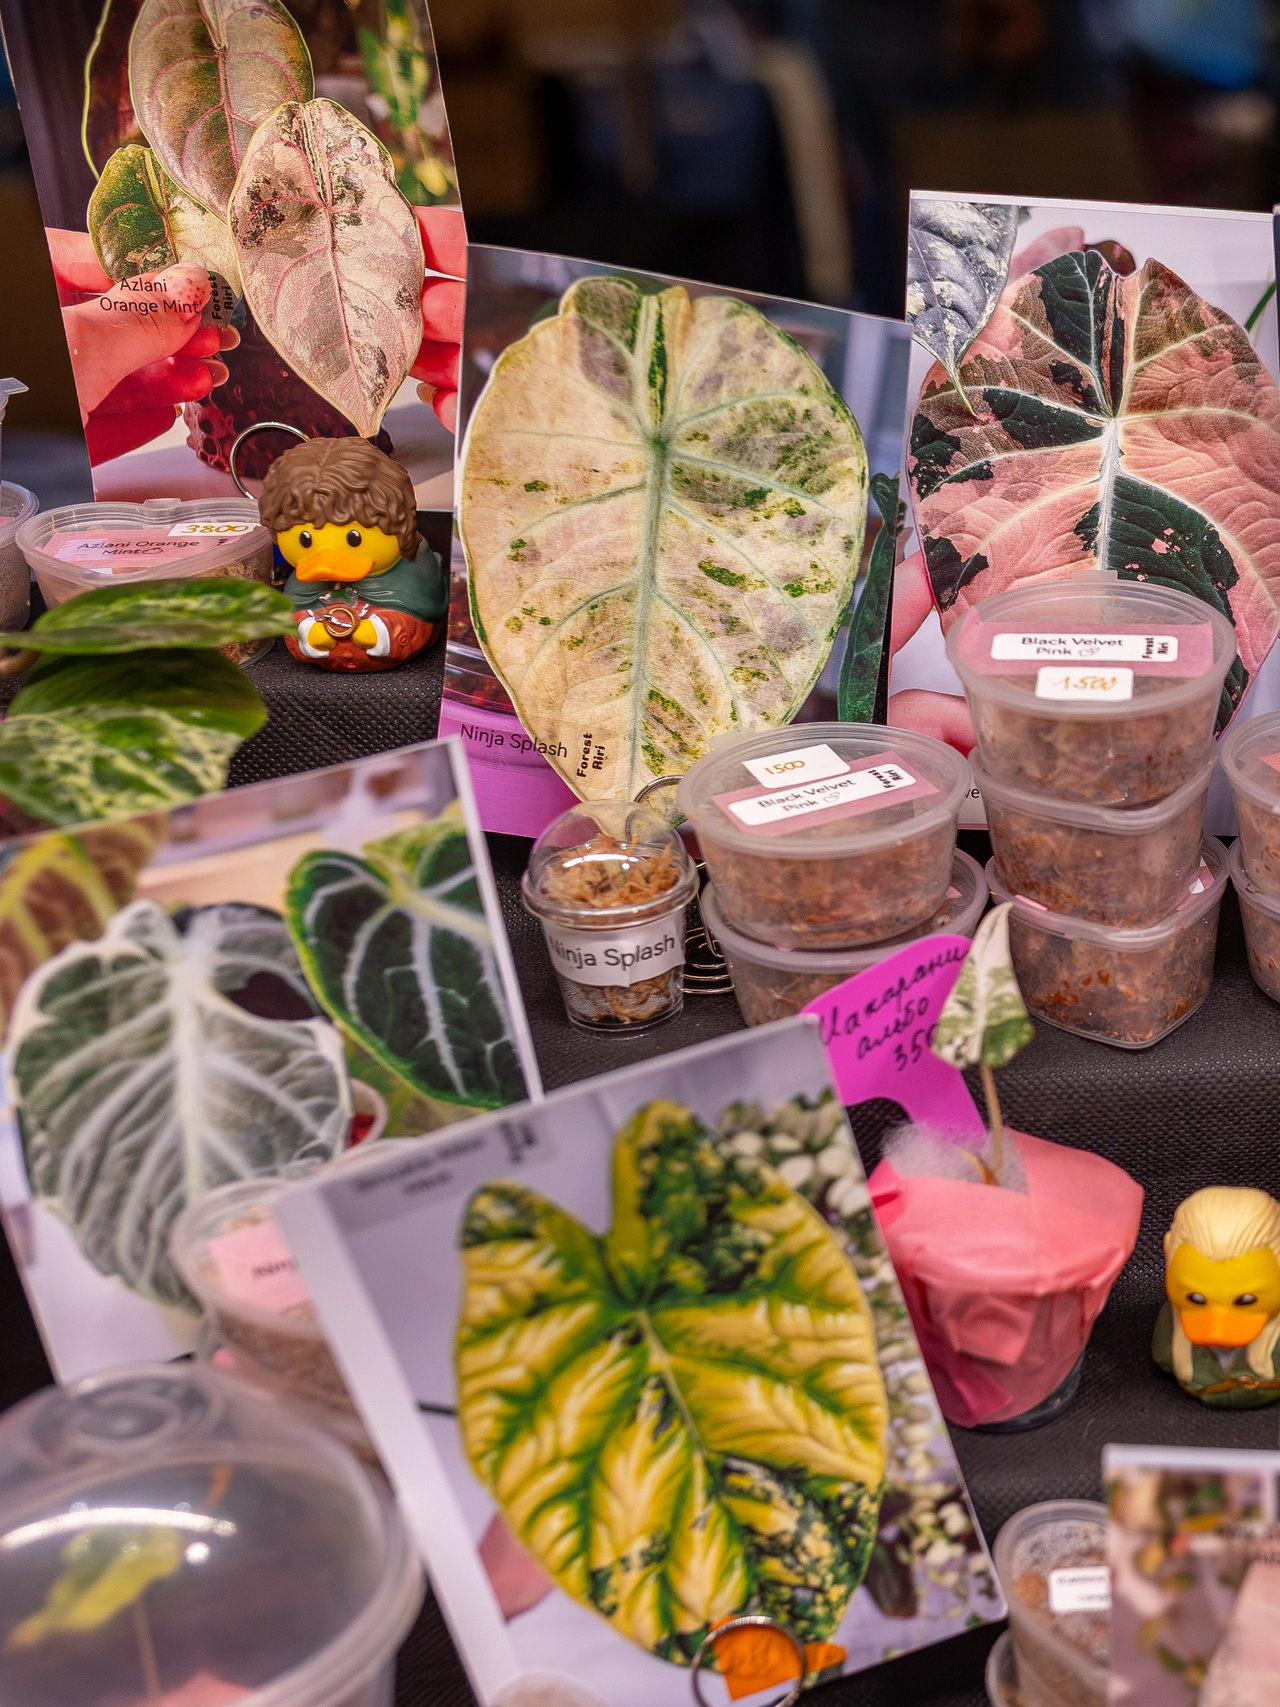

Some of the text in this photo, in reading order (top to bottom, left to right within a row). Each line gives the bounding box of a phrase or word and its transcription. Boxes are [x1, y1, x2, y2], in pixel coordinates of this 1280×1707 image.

[120, 277, 167, 292] Azlani
[207, 274, 222, 320] Forest
[221, 285, 234, 310] Riri
[100, 297, 200, 316] Orange Mint
[180, 524, 249, 534] 3800
[77, 539, 200, 549] Azlani Orange
[1022, 637, 1124, 647] Black Velvet
[1036, 648, 1072, 656] Pink
[1052, 675, 1118, 691] 1500
[461, 724, 568, 758] Ninja Splash
[576, 732, 593, 778] Forest
[592, 745, 606, 770] Riri
[764, 760, 806, 775] 1500
[758, 779, 857, 808] Black Velvet
[782, 799, 820, 812] Pink
[550, 934, 675, 971] Ninja Splash
